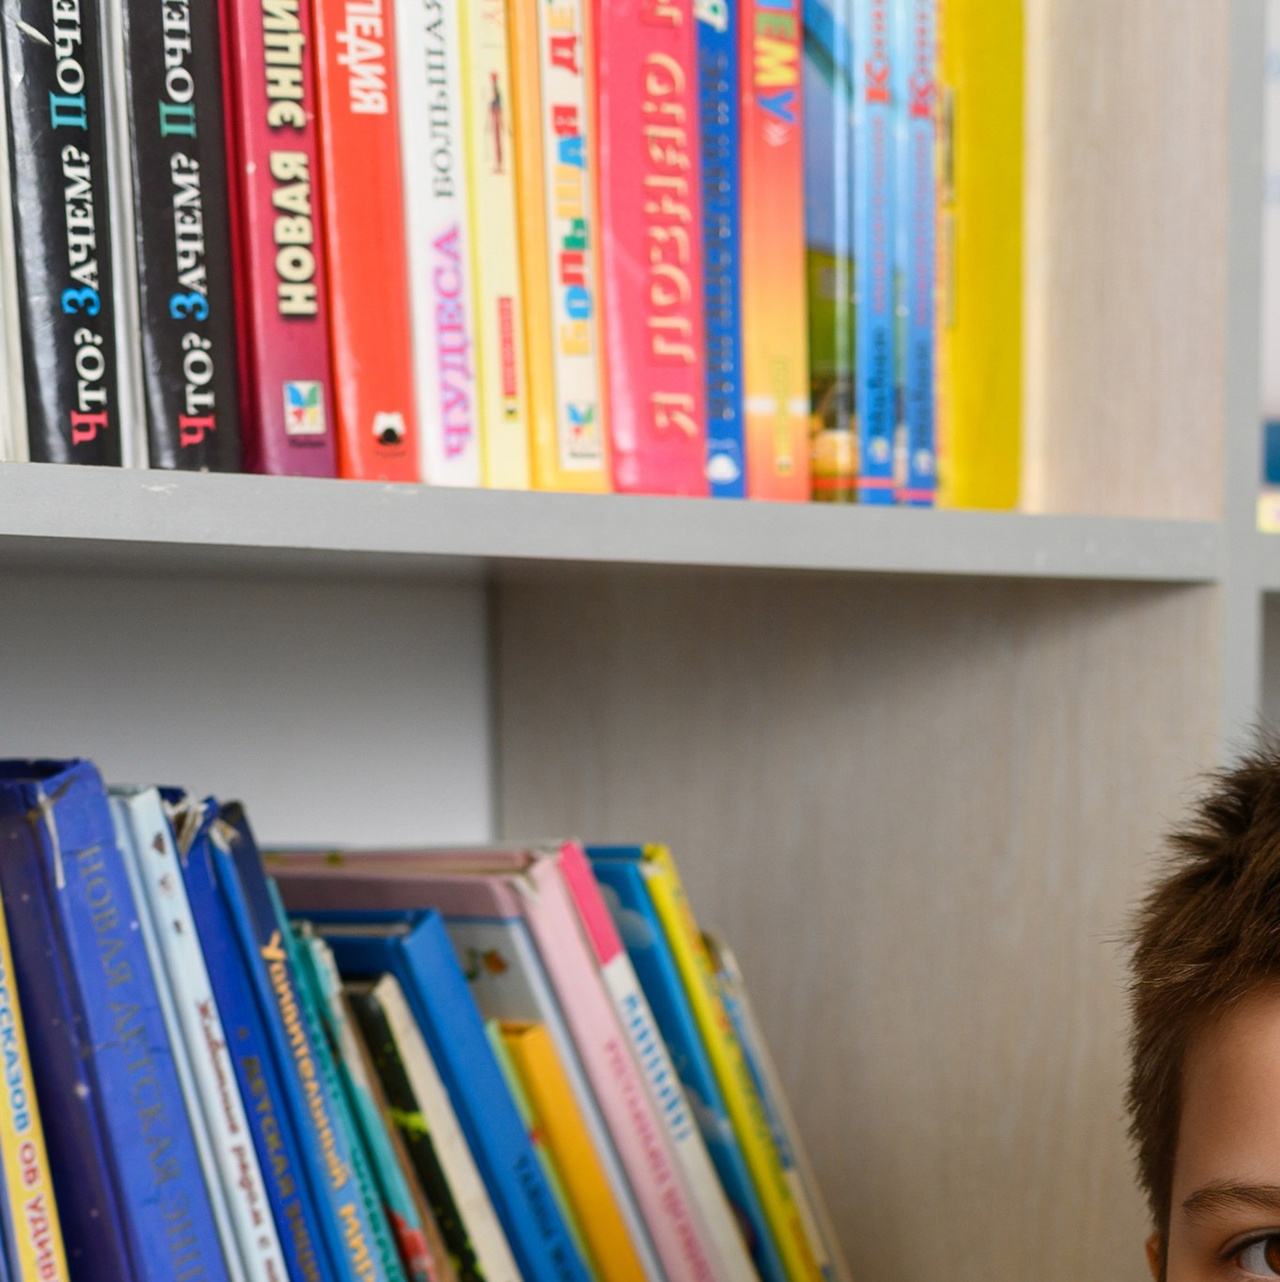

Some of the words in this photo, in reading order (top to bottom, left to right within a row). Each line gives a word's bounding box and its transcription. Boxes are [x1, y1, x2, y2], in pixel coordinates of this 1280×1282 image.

[269, 150, 319, 317] НОВАЯ
[550, 103, 594, 358] БОЛЬШАЯ
[638, 52, 696, 366] ПОЗНАЮ
[430, 222, 473, 462] ЧУДЕСА
[652, 391, 699, 437] Я
[78, 846, 132, 989] НОВАЯ
[109, 1000, 182, 1187] ДЕТСКАЯ
[21, 1138, 40, 1190] ОБ
[241, 1056, 297, 1200] ДЕТСКАЯ
